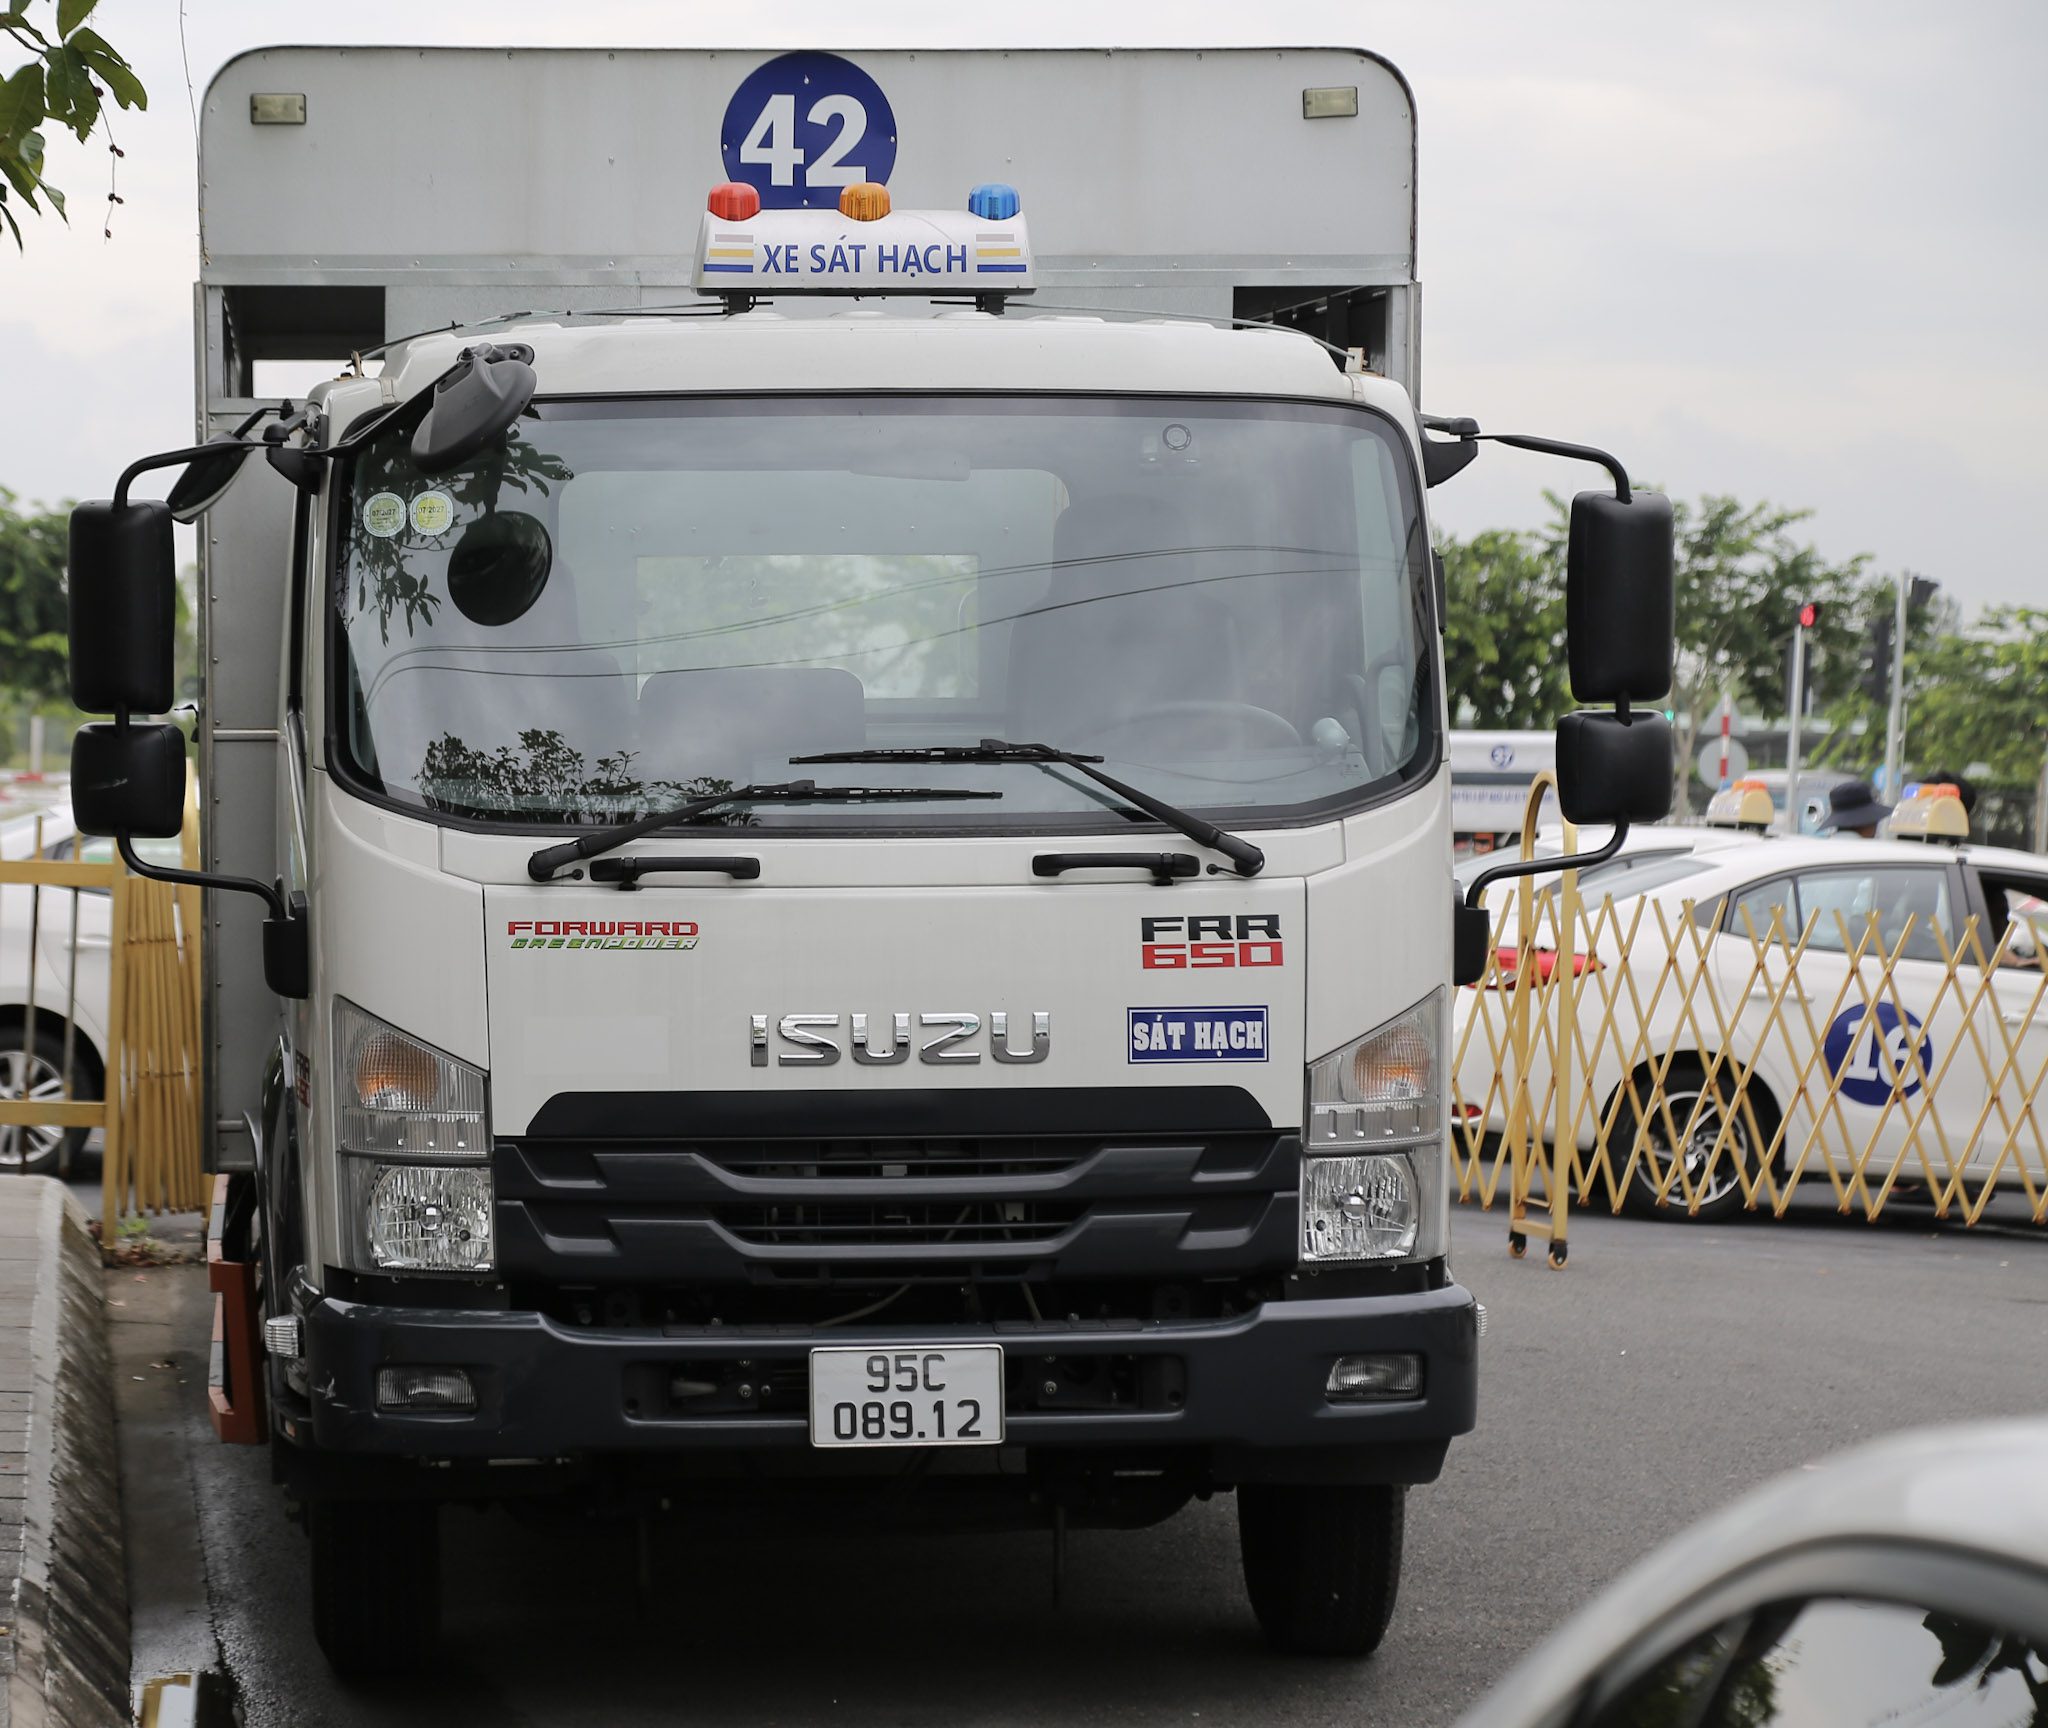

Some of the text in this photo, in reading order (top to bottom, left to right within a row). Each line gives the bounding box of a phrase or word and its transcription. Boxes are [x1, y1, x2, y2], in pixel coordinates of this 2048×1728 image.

[739, 94, 868, 188] 42
[761, 234, 968, 278] XE SÁT HẠCH
[507, 921, 699, 936] FORWARD
[1141, 914, 1283, 942] FRR
[1142, 941, 1284, 969] 650
[750, 1011, 1051, 1067] ISUZU
[1133, 1014, 1264, 1057] SÁT HẠCH
[1843, 1018, 1928, 1089] 16
[866, 1353, 946, 1393] 95C
[833, 1399, 981, 1440] 089.12
